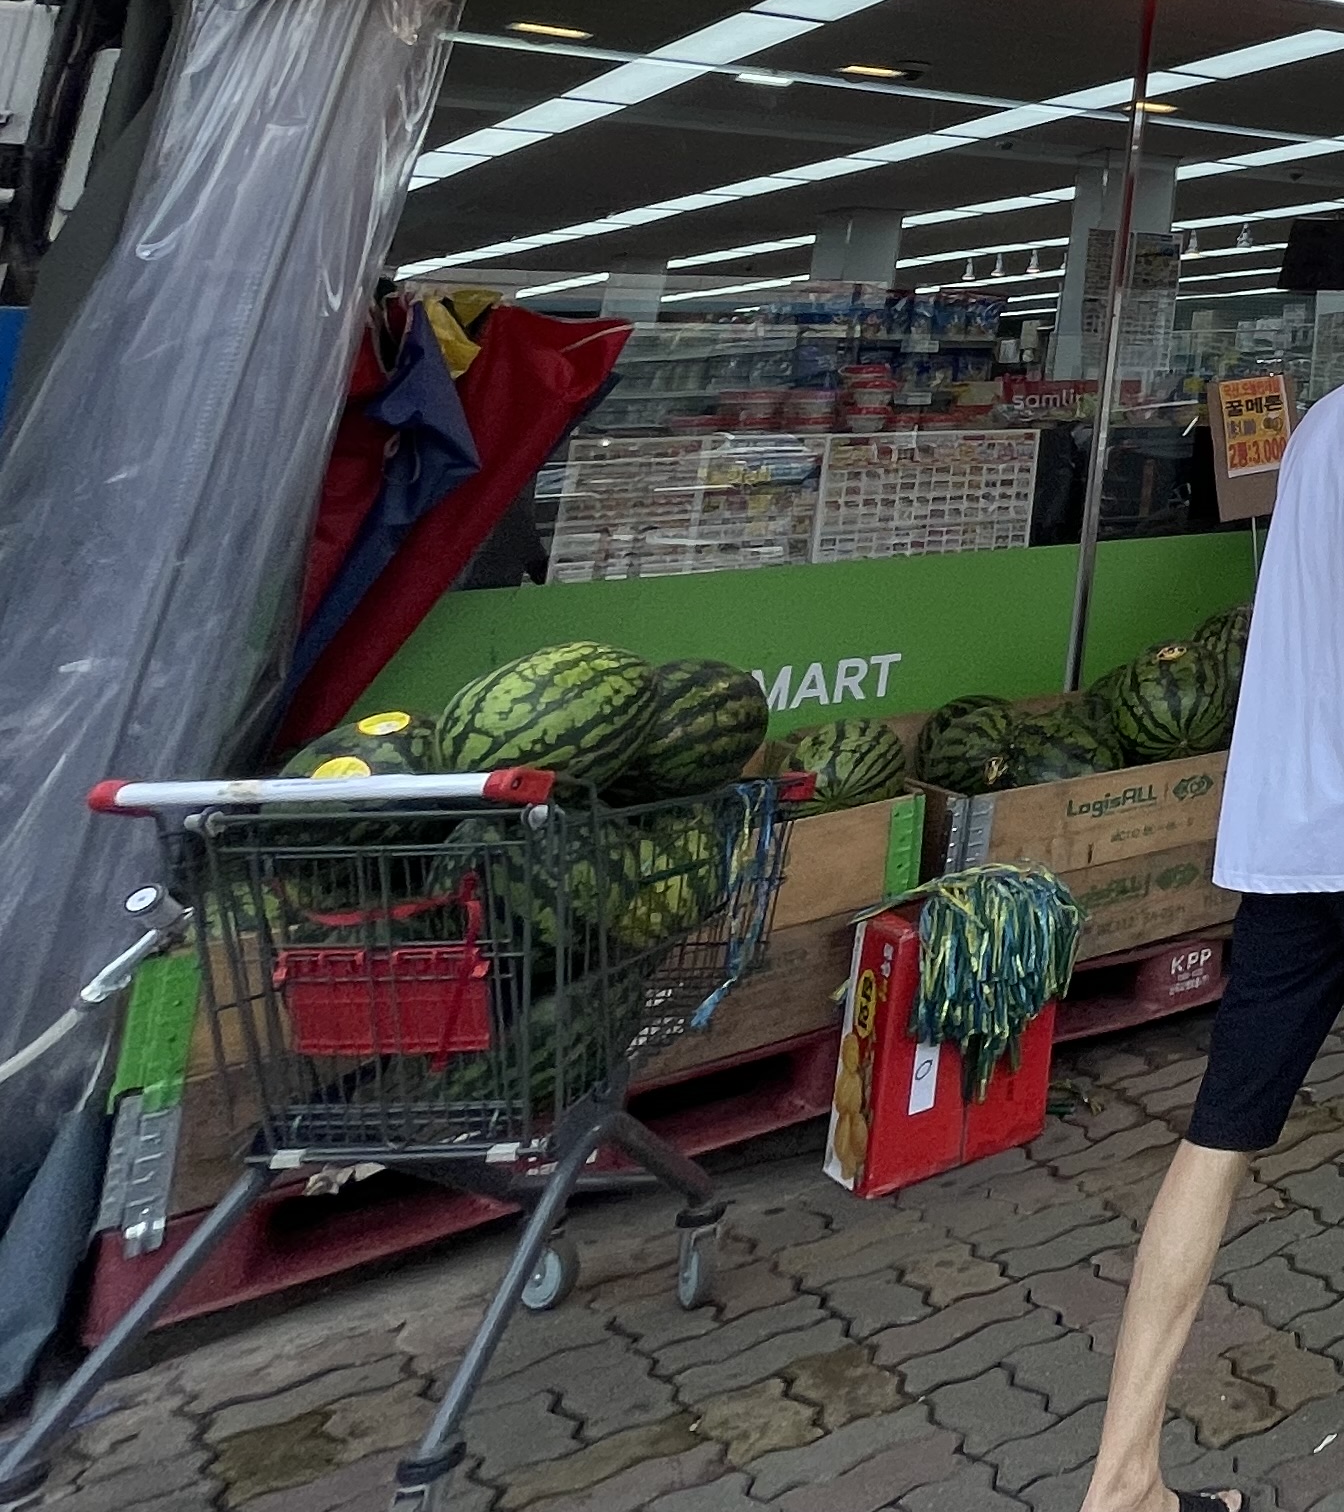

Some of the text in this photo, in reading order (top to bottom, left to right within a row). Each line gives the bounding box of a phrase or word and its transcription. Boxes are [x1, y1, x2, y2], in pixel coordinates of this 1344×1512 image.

[1012, 388, 1083, 410] samli
[753, 653, 902, 712] MART
[1067, 784, 1157, 818] LogisALL
[1170, 948, 1212, 975] KPP
